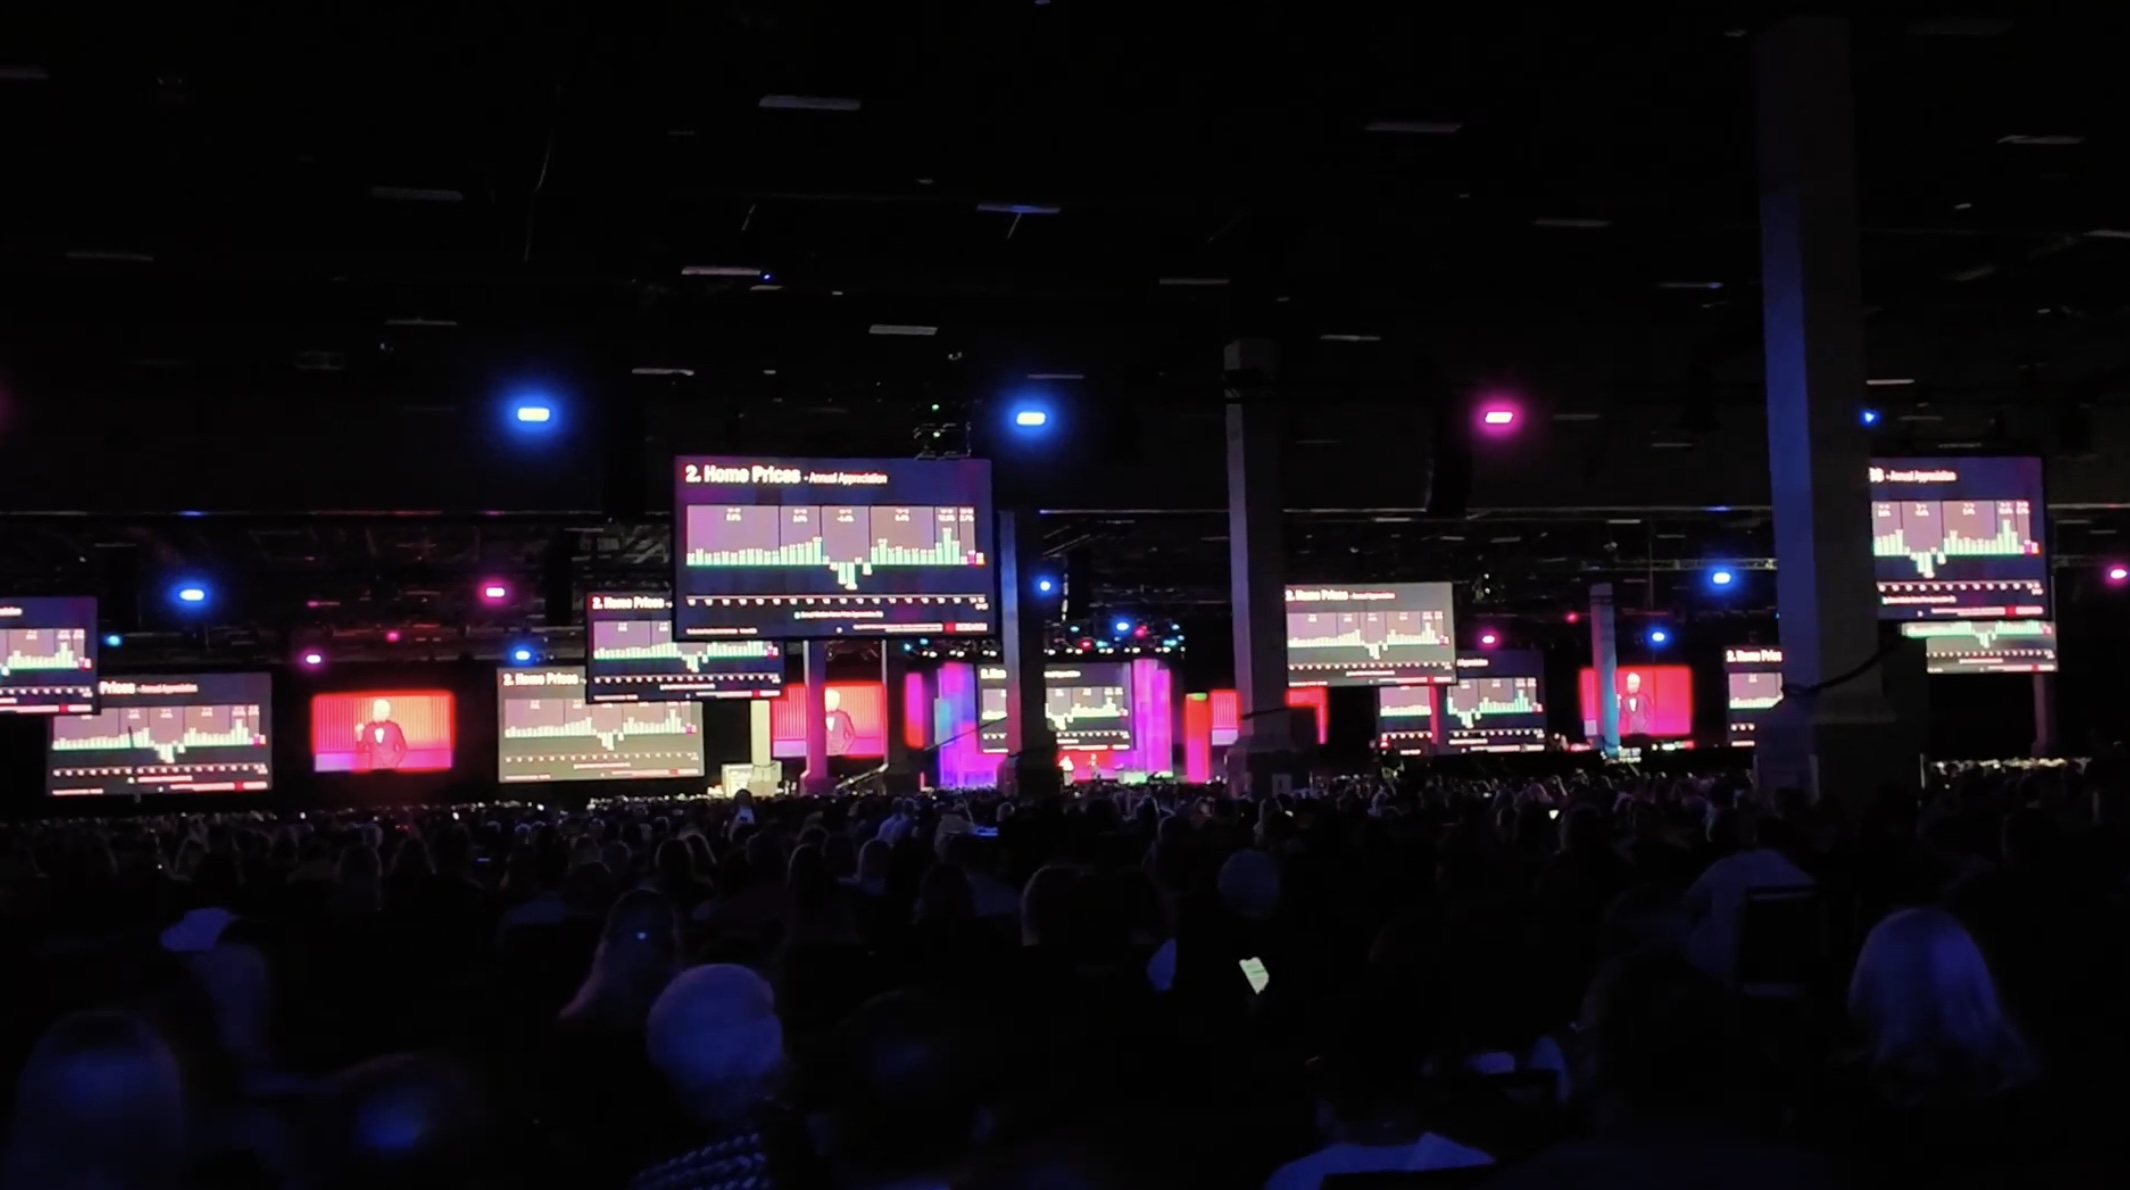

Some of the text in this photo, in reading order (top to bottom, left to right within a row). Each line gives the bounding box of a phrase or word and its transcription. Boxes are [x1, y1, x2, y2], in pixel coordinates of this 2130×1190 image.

[686, 464, 702, 483] 2.
[704, 465, 750, 483] Home
[752, 466, 801, 484] Prices
